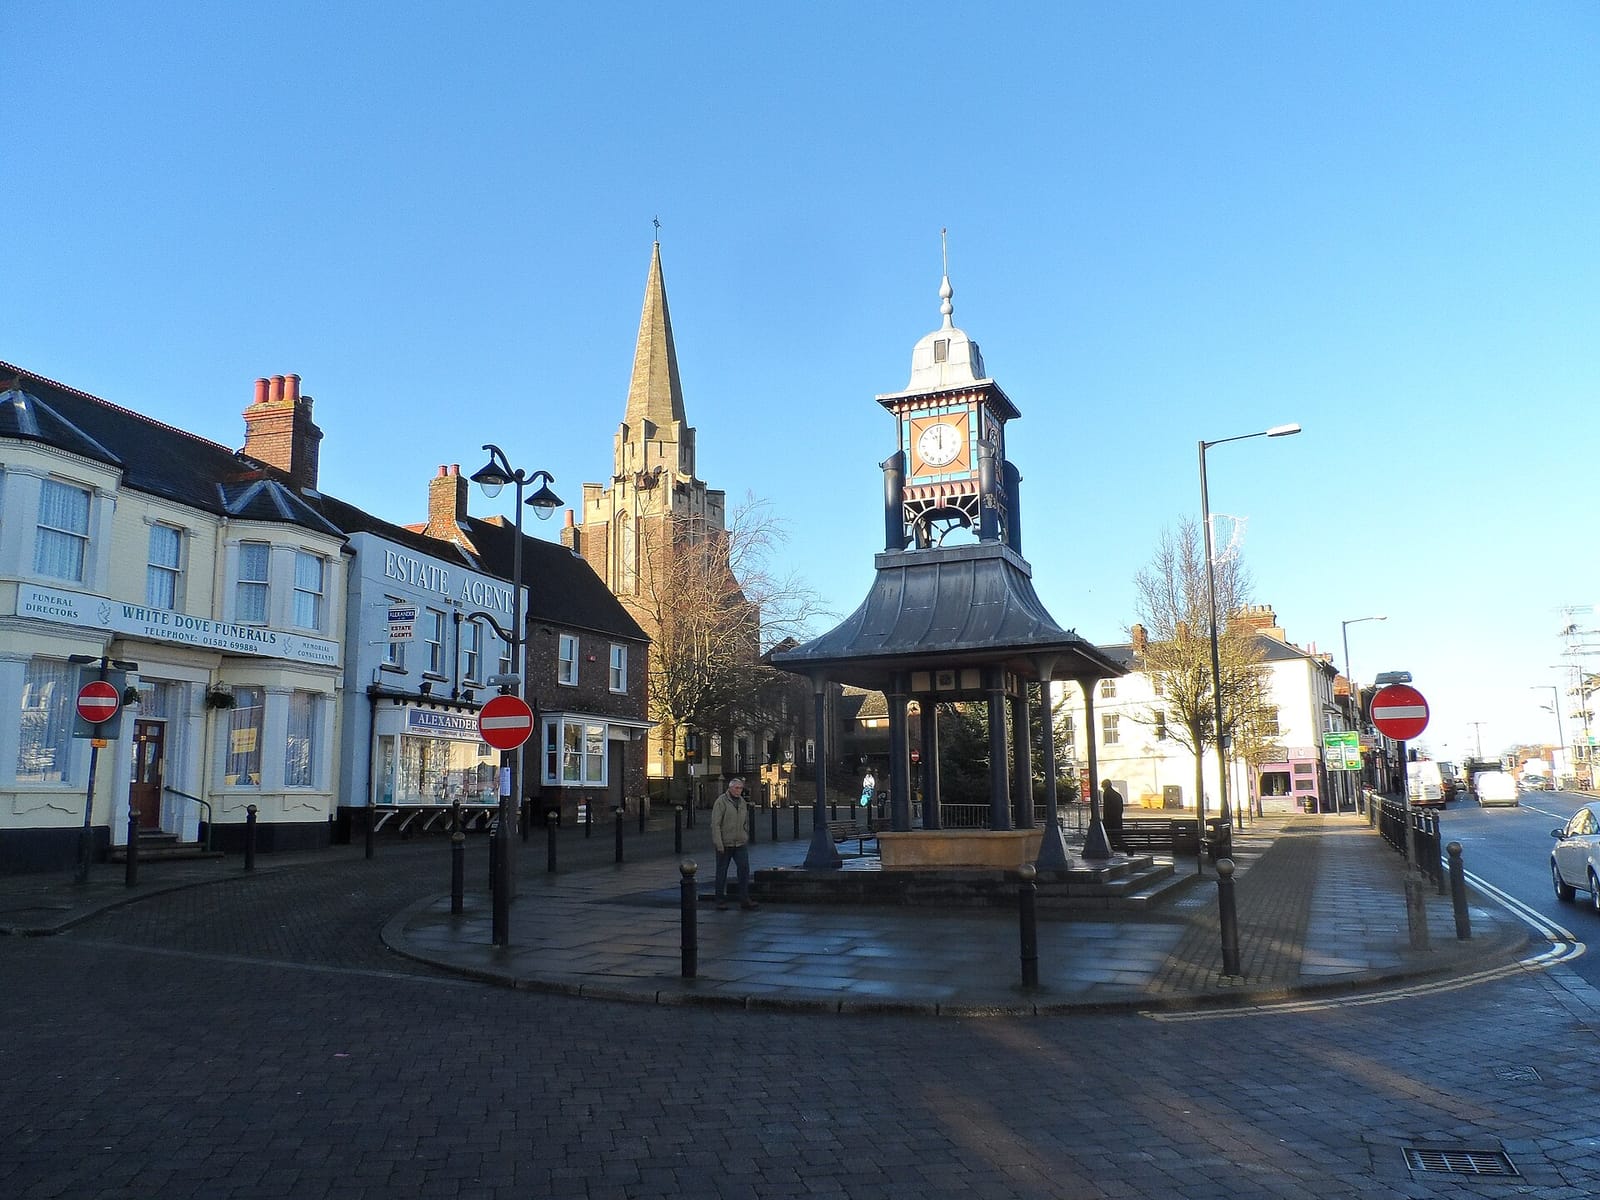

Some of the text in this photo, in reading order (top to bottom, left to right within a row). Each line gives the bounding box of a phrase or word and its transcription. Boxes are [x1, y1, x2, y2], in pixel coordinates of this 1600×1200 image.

[384, 550, 449, 595] ESTATE
[33, 593, 73, 607] FUNERAL
[26, 603, 78, 618] DIRECTORS
[122, 605, 277, 644] WHITE DOVE FUNERALS
[144, 626, 198, 642] TELEPHONE:
[203, 637, 227, 648] 01582
[418, 713, 478, 731] ALEXANDER
